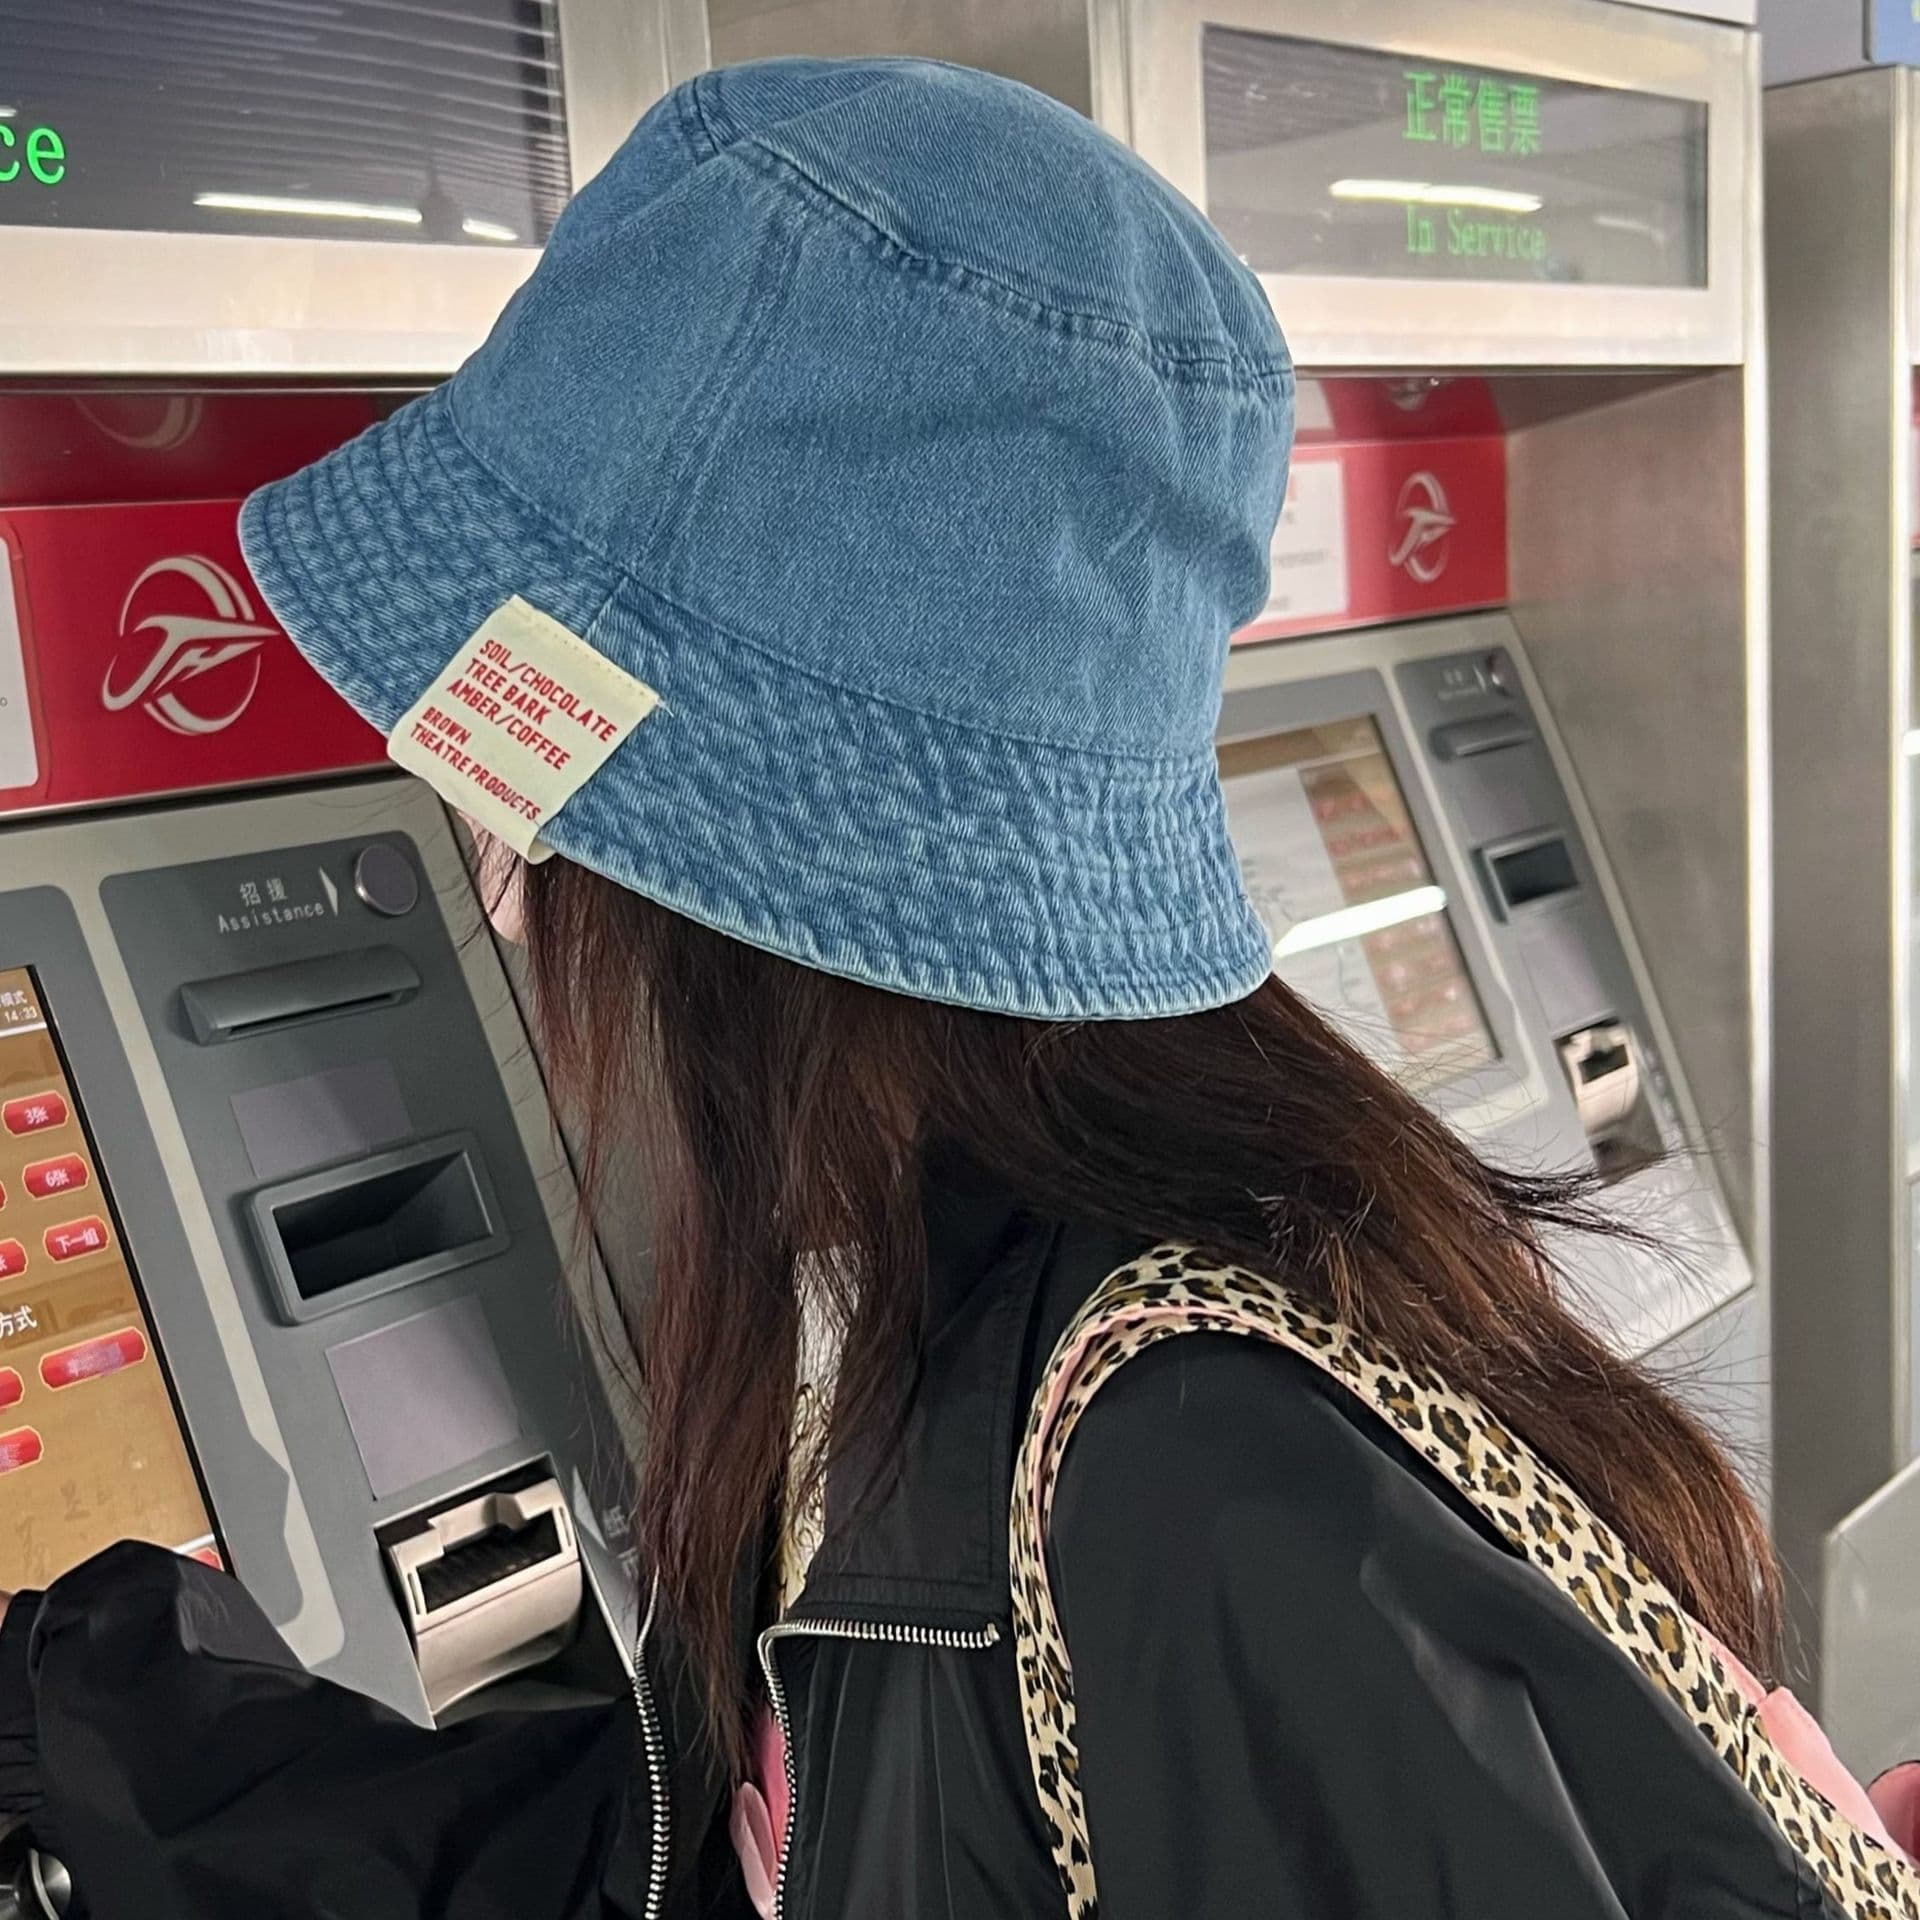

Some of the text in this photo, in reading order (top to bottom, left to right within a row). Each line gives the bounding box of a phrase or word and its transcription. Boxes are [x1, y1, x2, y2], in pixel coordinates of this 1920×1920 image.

[1402, 71, 1541, 154] 正常售票
[1407, 205, 1546, 260] In Service
[421, 706, 472, 746] BROWN
[446, 678, 571, 771] AMBER/COFFEE
[464, 658, 552, 726] TREE BARK
[479, 639, 618, 742] SOIL/CHOCOLATE
[409, 722, 541, 821] THEATRE PRODUCTS
[218, 902, 325, 933] Assistance
